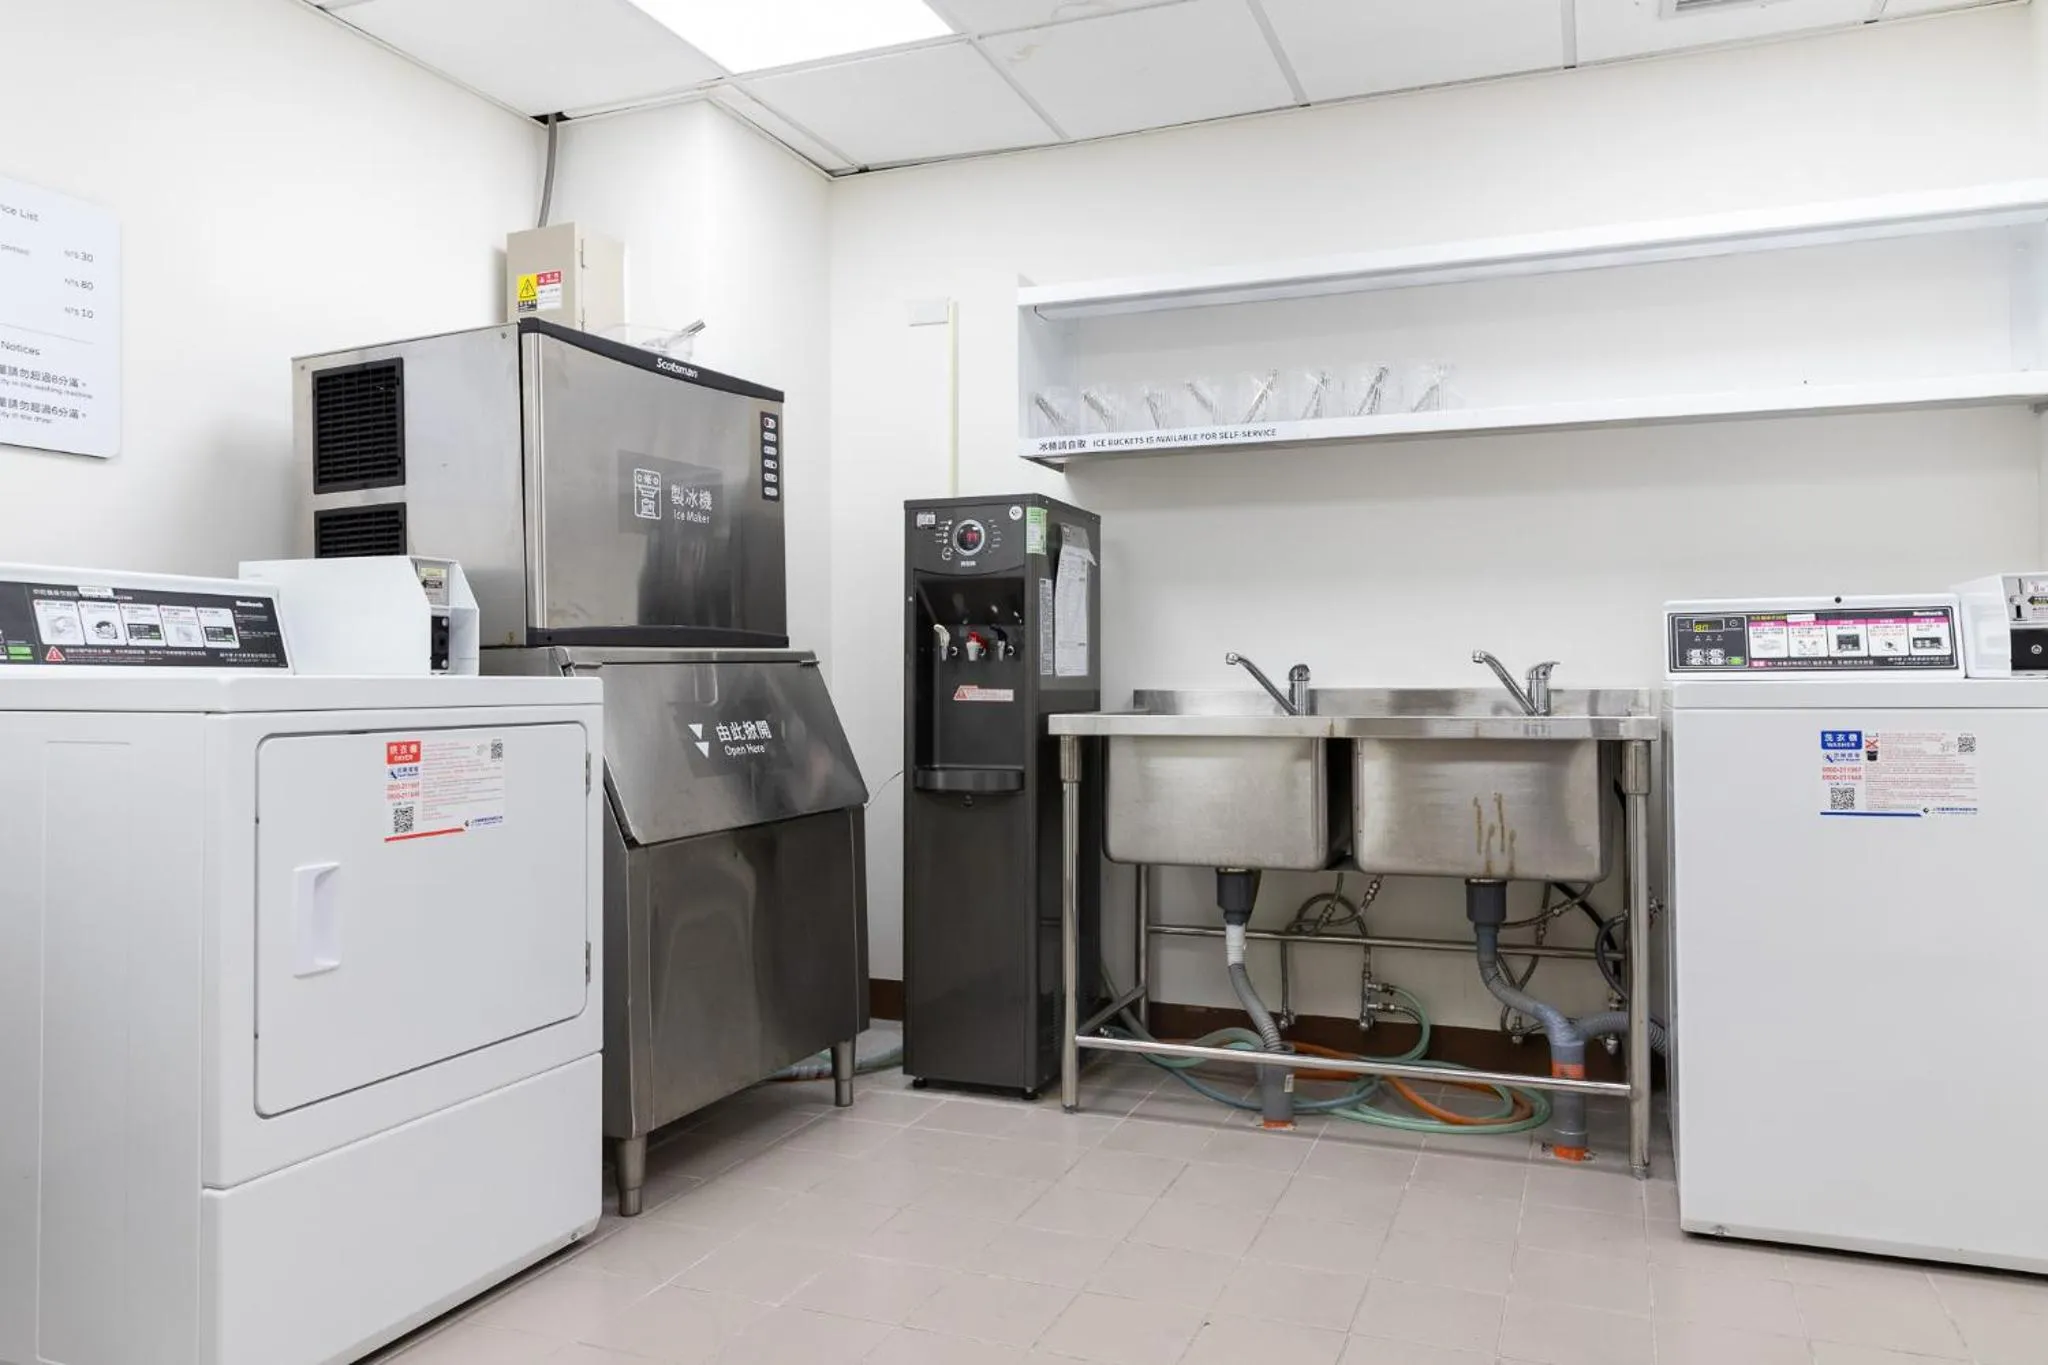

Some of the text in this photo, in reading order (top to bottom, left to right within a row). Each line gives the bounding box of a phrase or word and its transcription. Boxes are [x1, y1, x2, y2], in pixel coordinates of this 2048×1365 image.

[0, 340, 41, 356] Notices
[656, 357, 699, 379] Scotsman
[1093, 439, 1106, 447] ICE
[1108, 437, 1144, 446] BUCKETS
[1156, 433, 1198, 443] AVAILABLE
[1200, 432, 1217, 441] FOR
[1219, 428, 1277, 440] SELF-SERVICE
[671, 484, 713, 511] 製冰機
[673, 509, 710, 524] Ice Maker
[724, 743, 766, 758] Open Here
